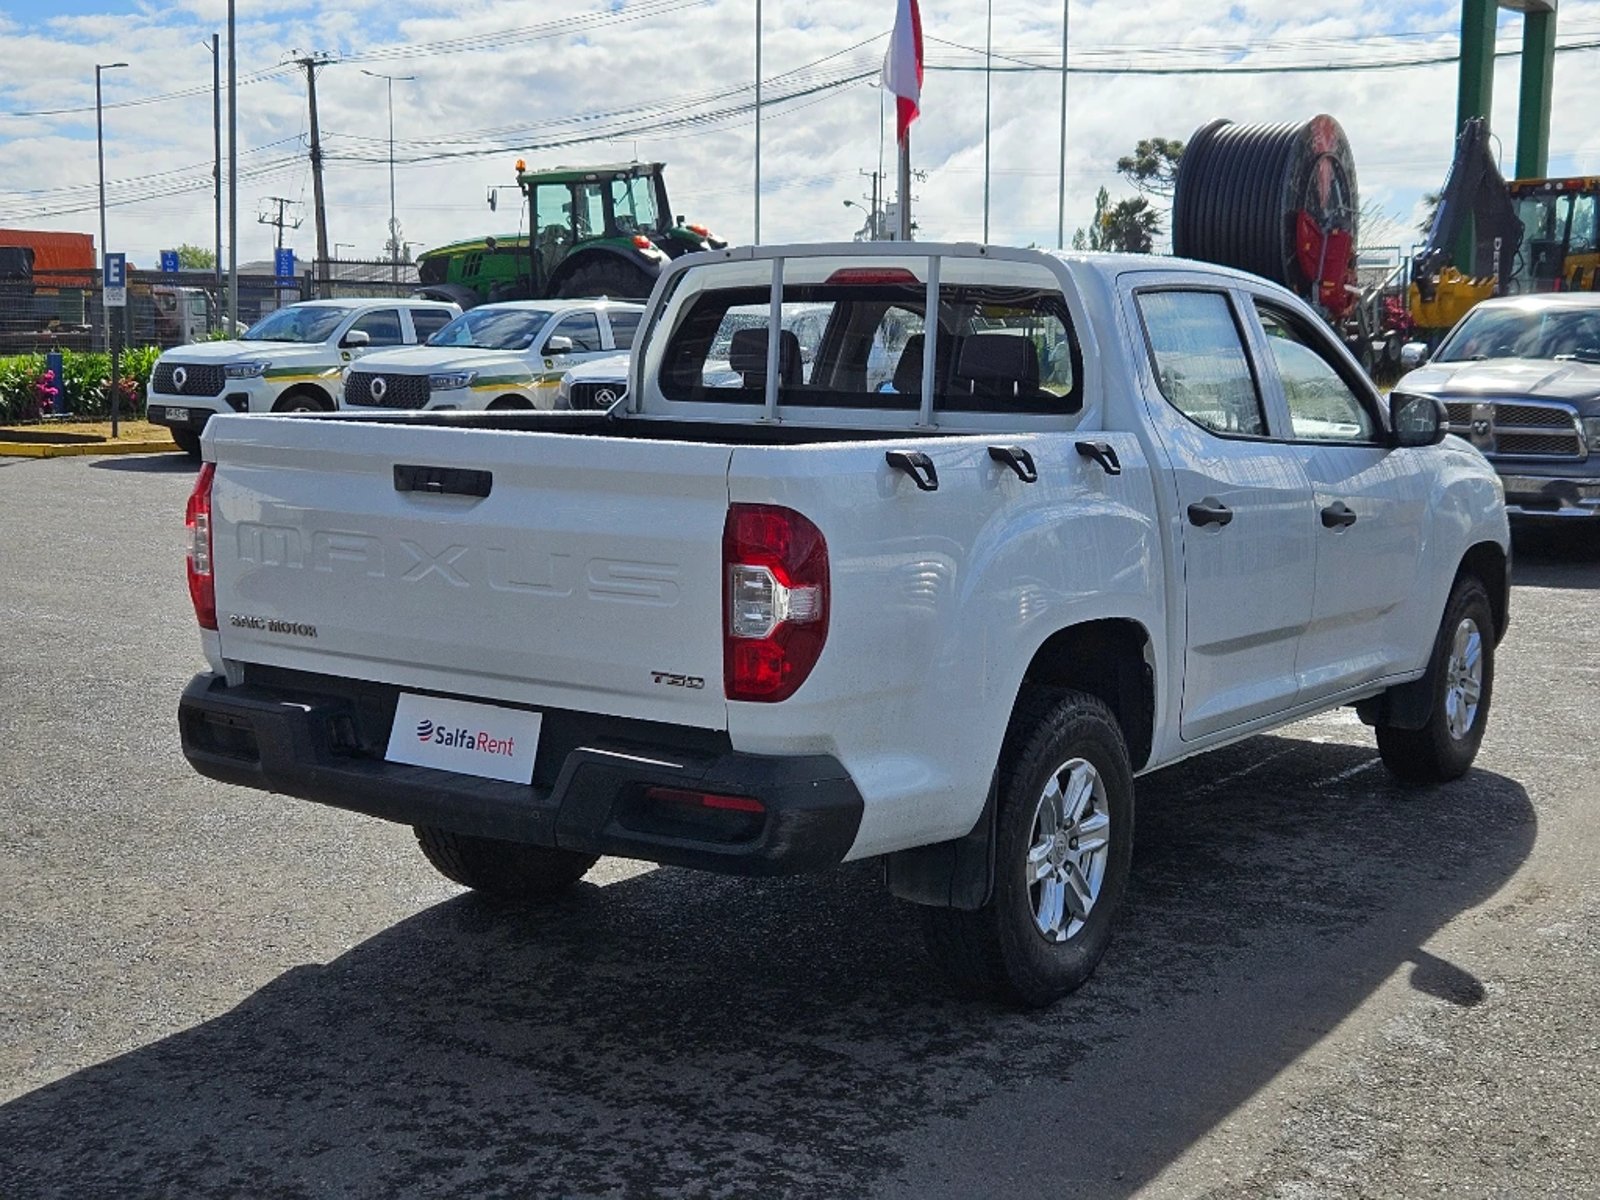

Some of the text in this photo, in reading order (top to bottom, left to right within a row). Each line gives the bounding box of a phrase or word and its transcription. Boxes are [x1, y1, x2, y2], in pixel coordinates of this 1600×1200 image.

[109, 258, 120, 282] E
[236, 521, 681, 608] MAXUS
[229, 614, 318, 638] SAIC MOTOR
[434, 725, 514, 757] SalfaRent
